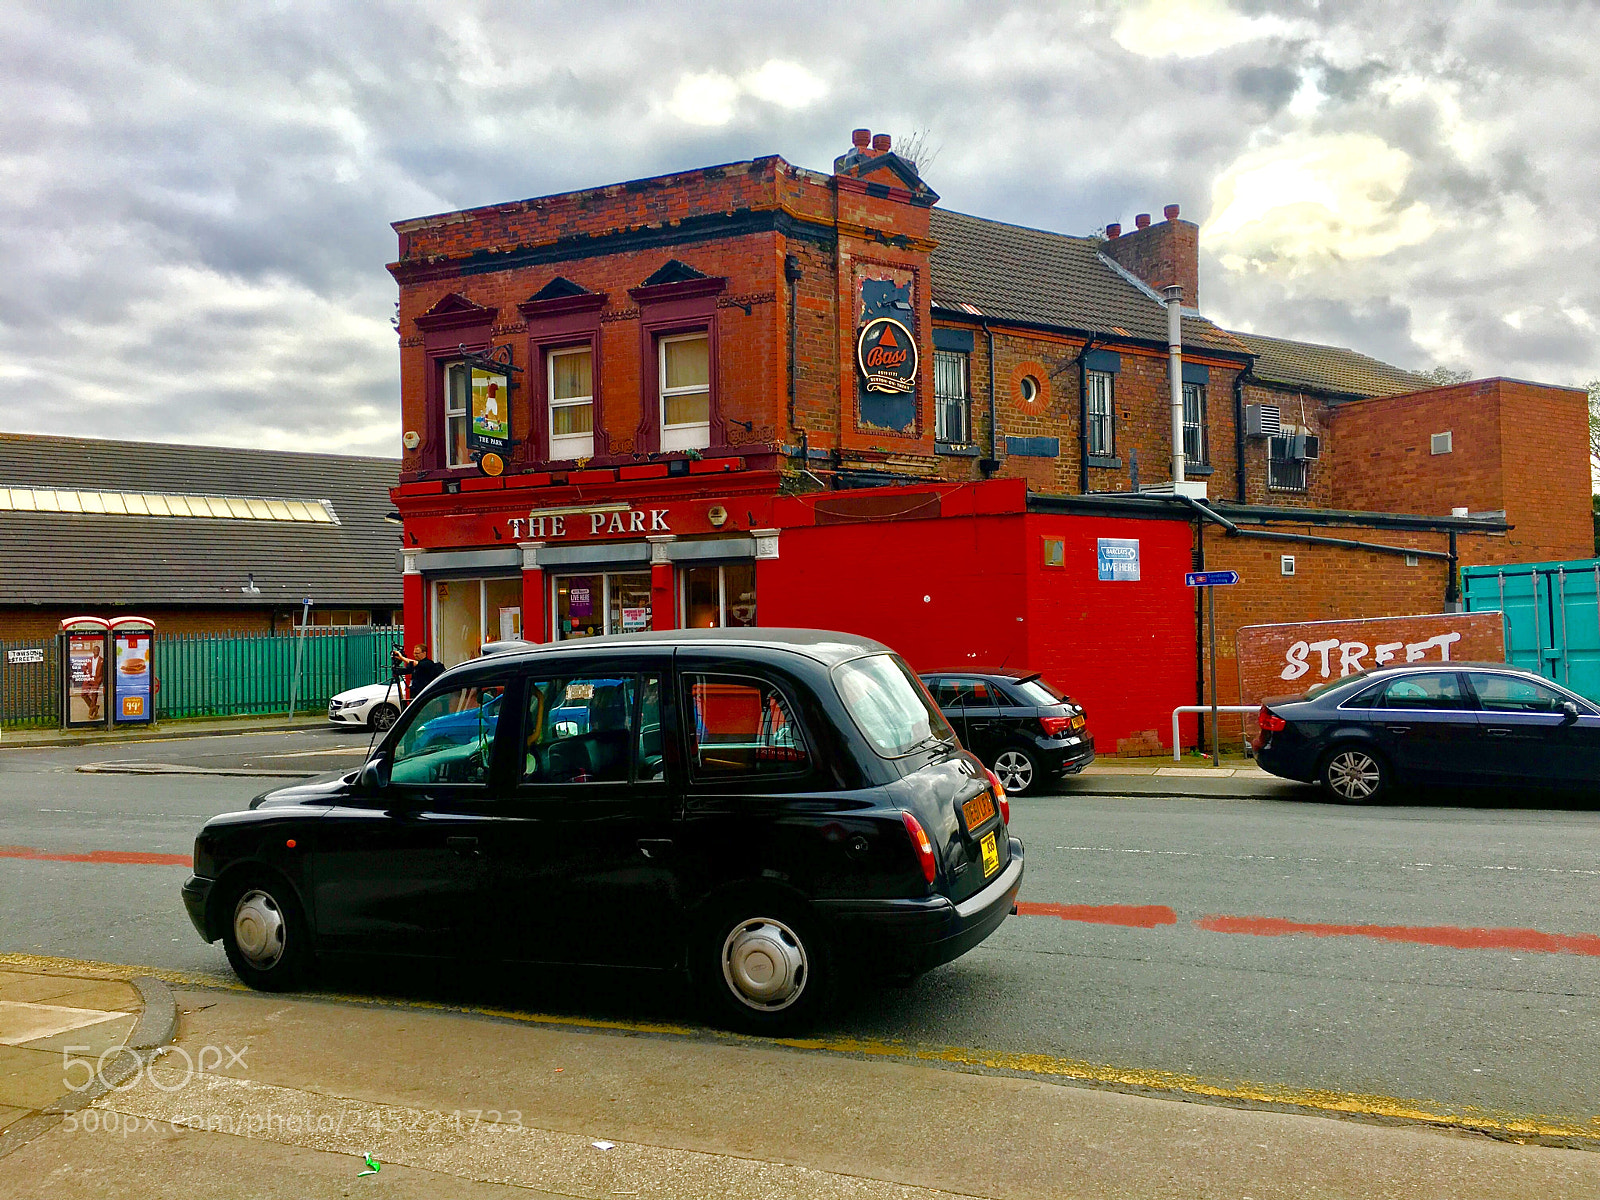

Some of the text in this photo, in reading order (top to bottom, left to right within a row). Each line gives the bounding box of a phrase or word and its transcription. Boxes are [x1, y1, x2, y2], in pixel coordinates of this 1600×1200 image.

[867, 346, 907, 367] Bass
[479, 435, 503, 446] THE PARK
[507, 509, 671, 539] THE PARK
[1101, 562, 1137, 572] LIVE HERE
[1280, 632, 1461, 681] STREET
